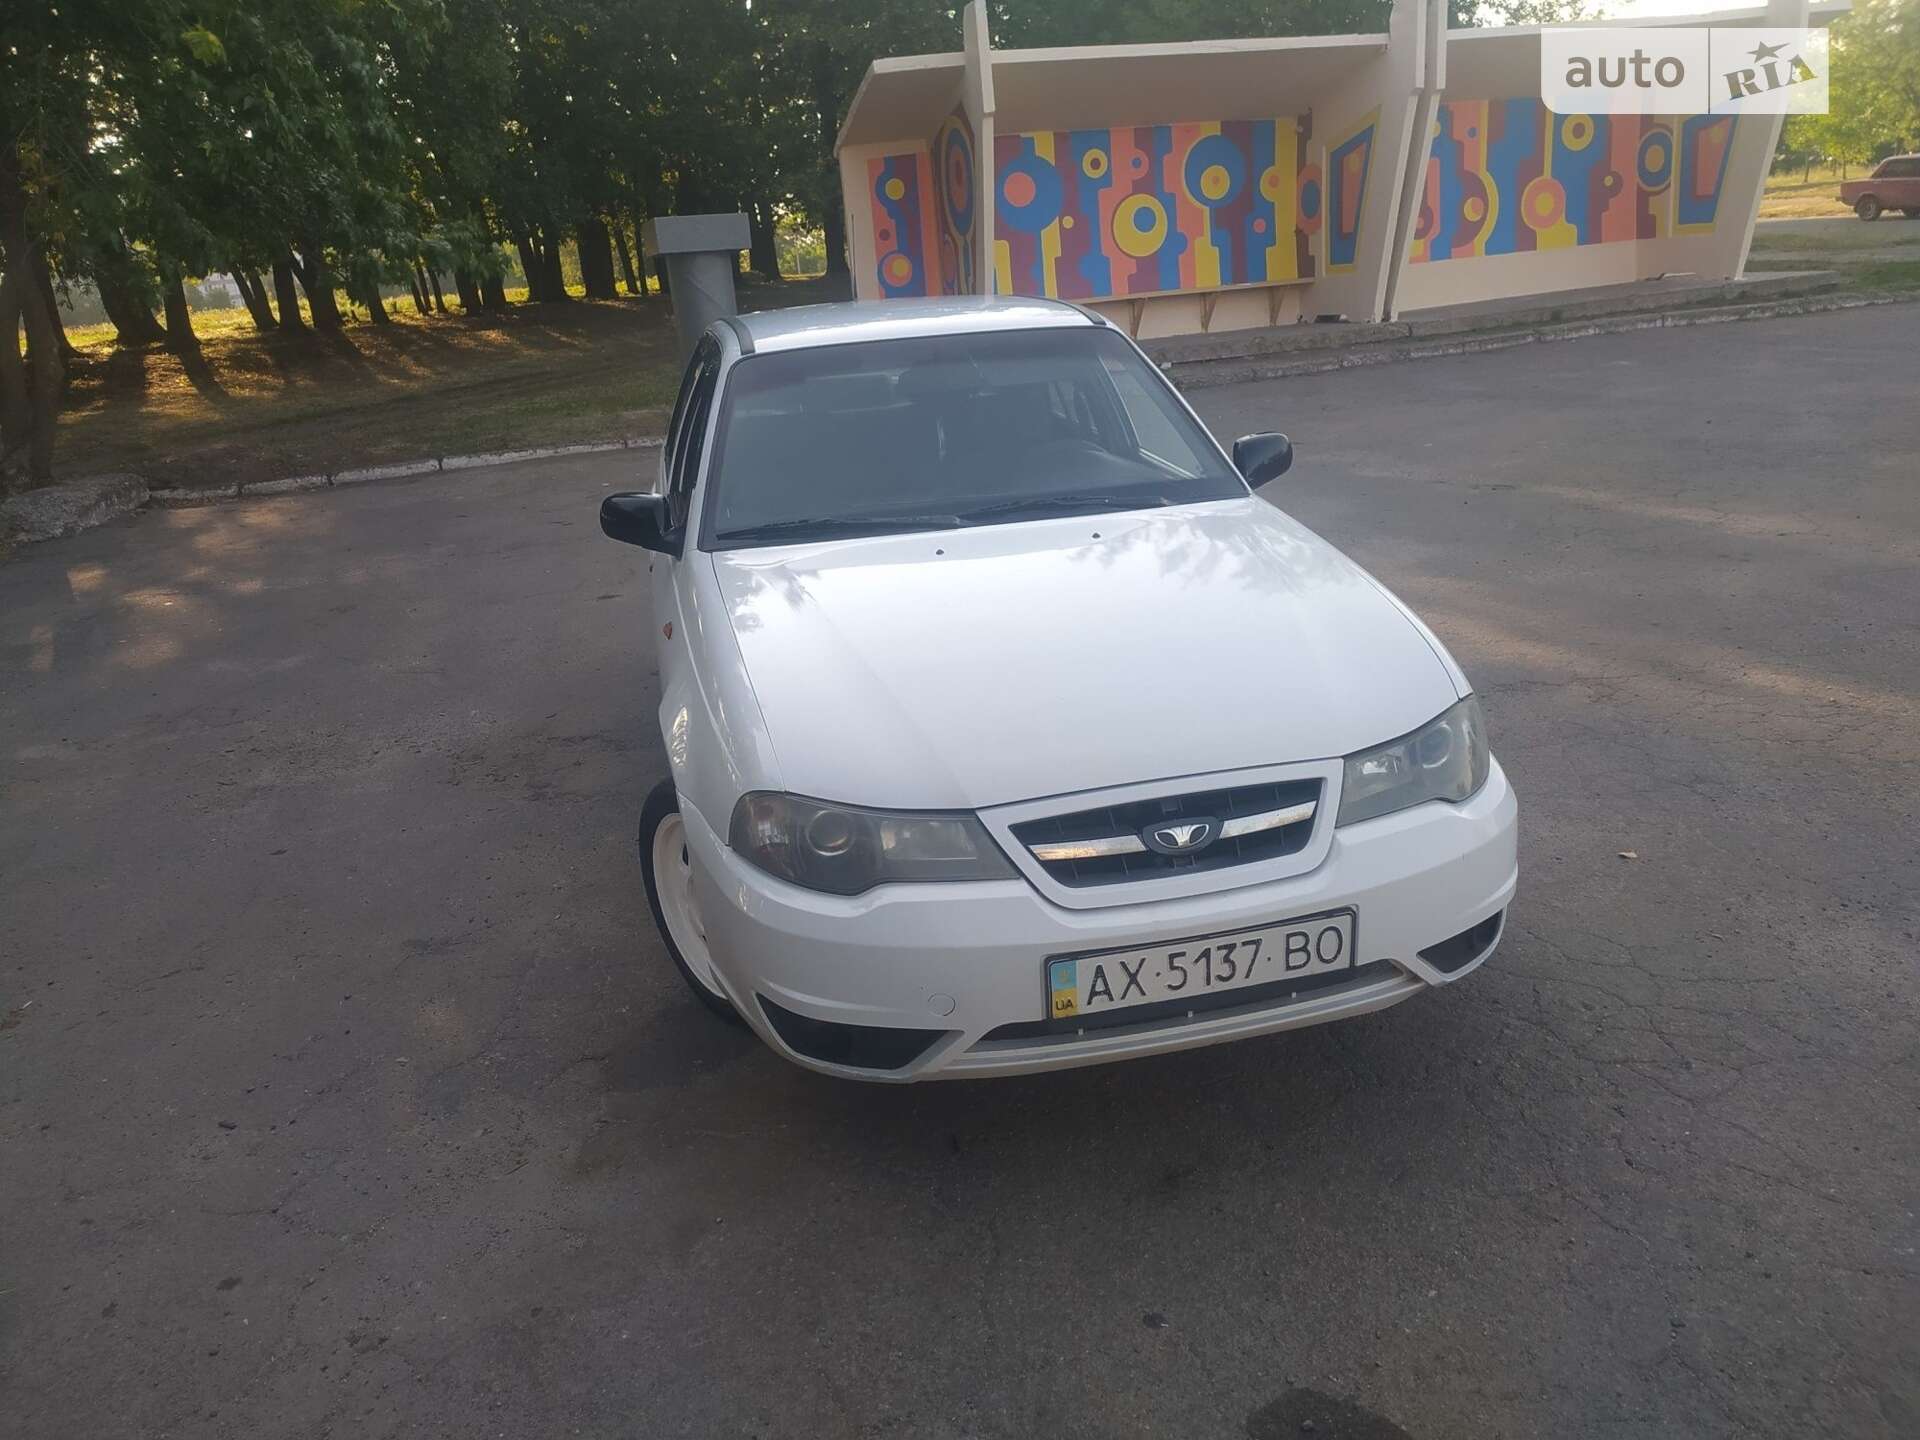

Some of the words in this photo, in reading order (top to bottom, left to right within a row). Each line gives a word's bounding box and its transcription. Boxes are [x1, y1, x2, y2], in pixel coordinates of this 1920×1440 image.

[1087, 957, 1146, 1006] AX
[1167, 938, 1262, 990] 5137
[1055, 999, 1073, 1011] UA
